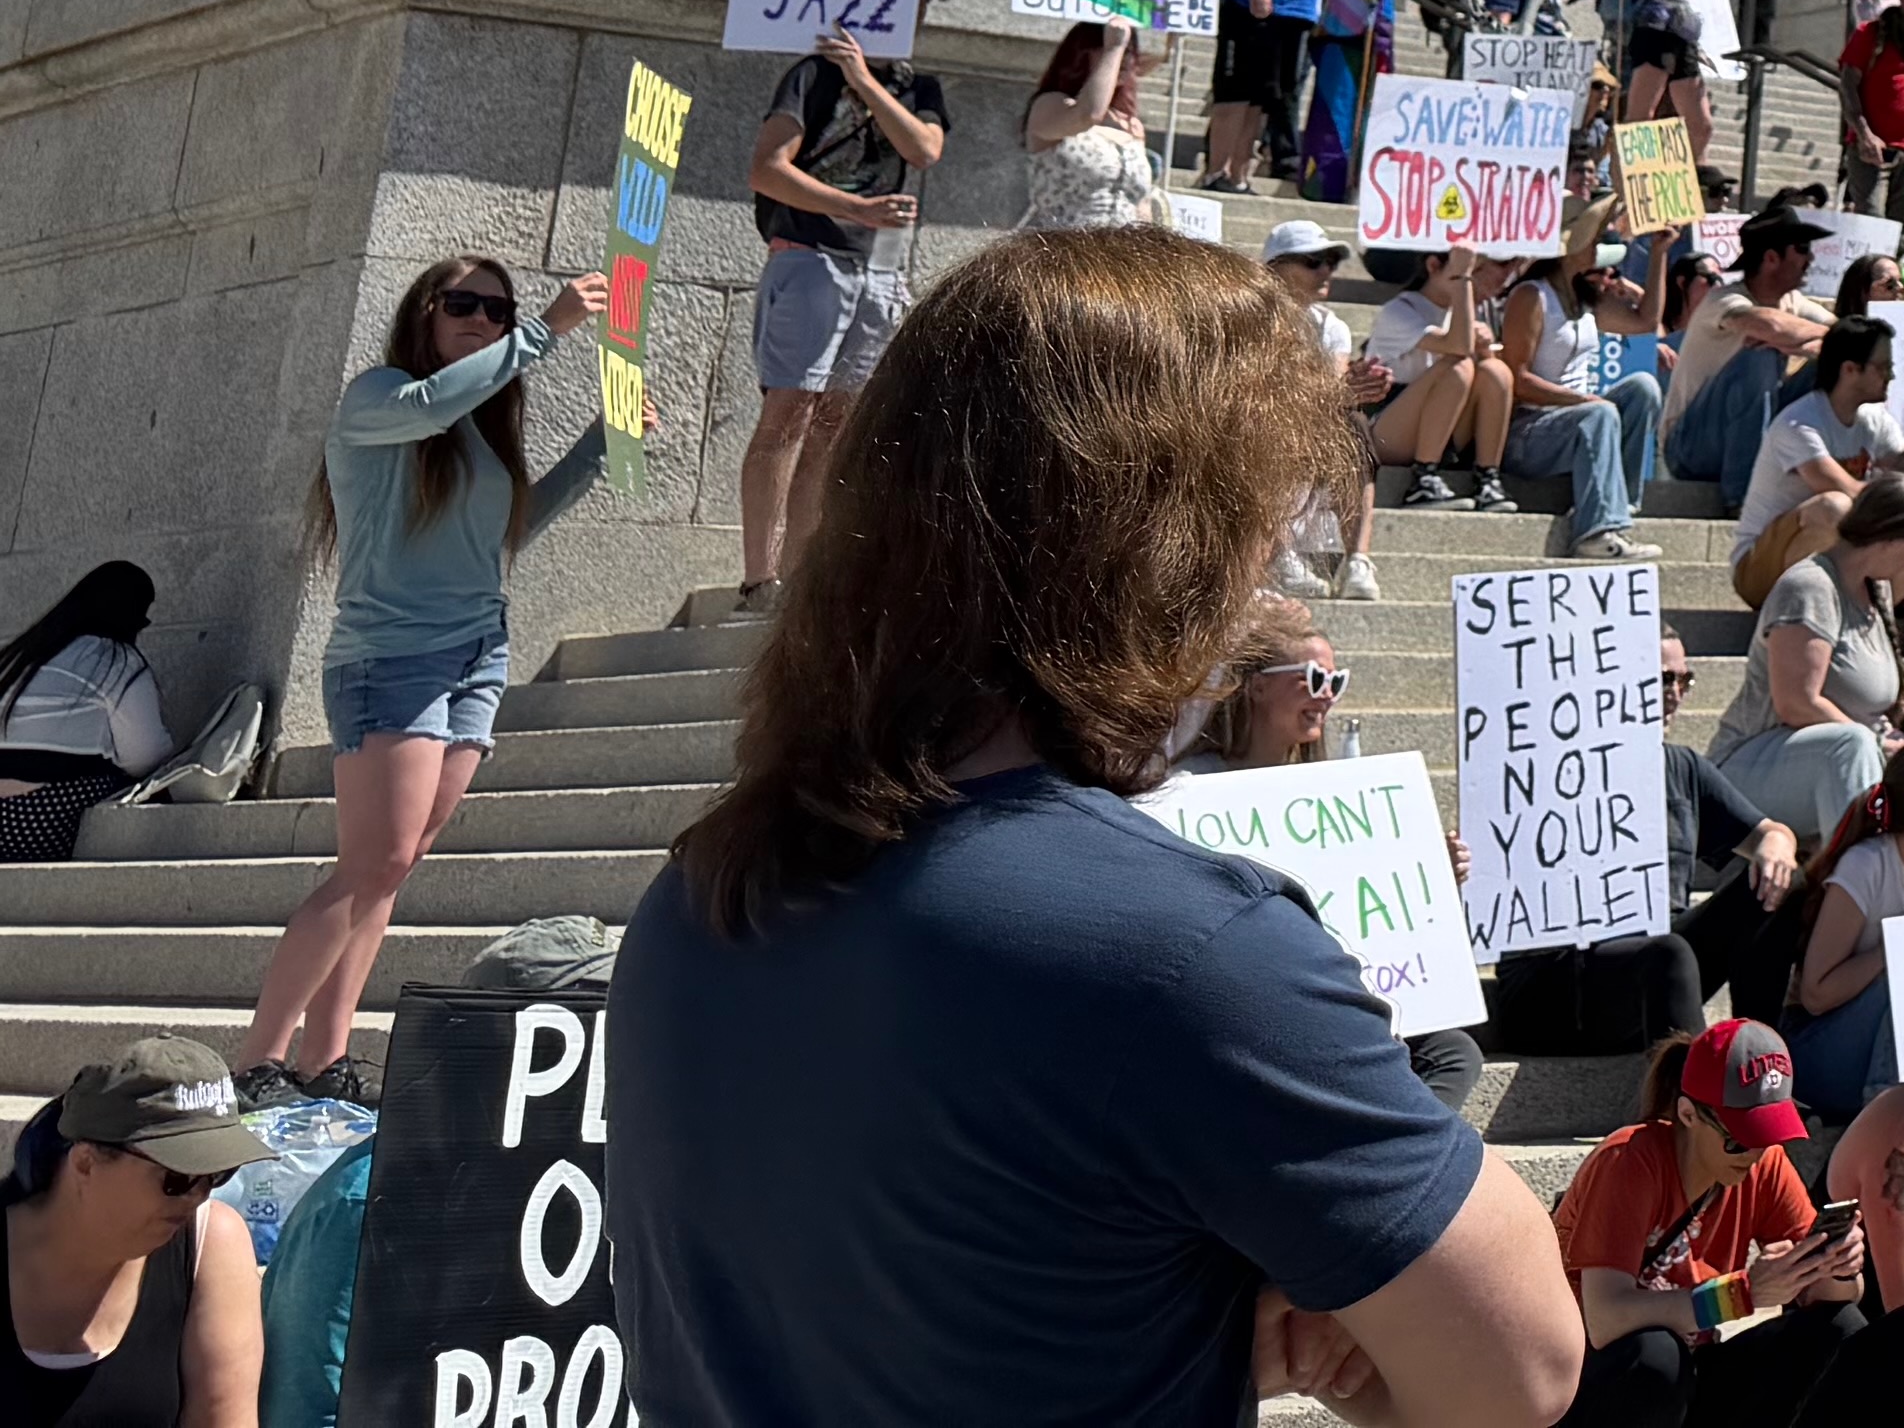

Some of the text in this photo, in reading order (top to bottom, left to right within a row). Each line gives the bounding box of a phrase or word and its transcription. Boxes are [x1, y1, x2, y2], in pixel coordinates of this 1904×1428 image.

[1470, 38, 1597, 71] STOP HEAT
[624, 60, 693, 169] CHOOSE
[1394, 91, 1571, 148] SAVE WATER
[1621, 122, 1689, 167] EARTH PAYS
[616, 152, 667, 246] WILD
[1363, 147, 1561, 243] STOP STRATOS
[1626, 169, 1696, 229] THE PRICE
[1465, 569, 1653, 635] SERVE
[1501, 626, 1619, 689] THE
[1464, 678, 1661, 762] PEOPLE
[1504, 742, 1624, 815] NOT
[1284, 785, 1404, 848] CAN'T
[1490, 794, 1639, 881] YOUR
[1356, 862, 1436, 940] AI!
[1465, 861, 1666, 950] WALLET
[1363, 952, 1430, 994] OX!
[433, 1324, 639, 1428] PRO
